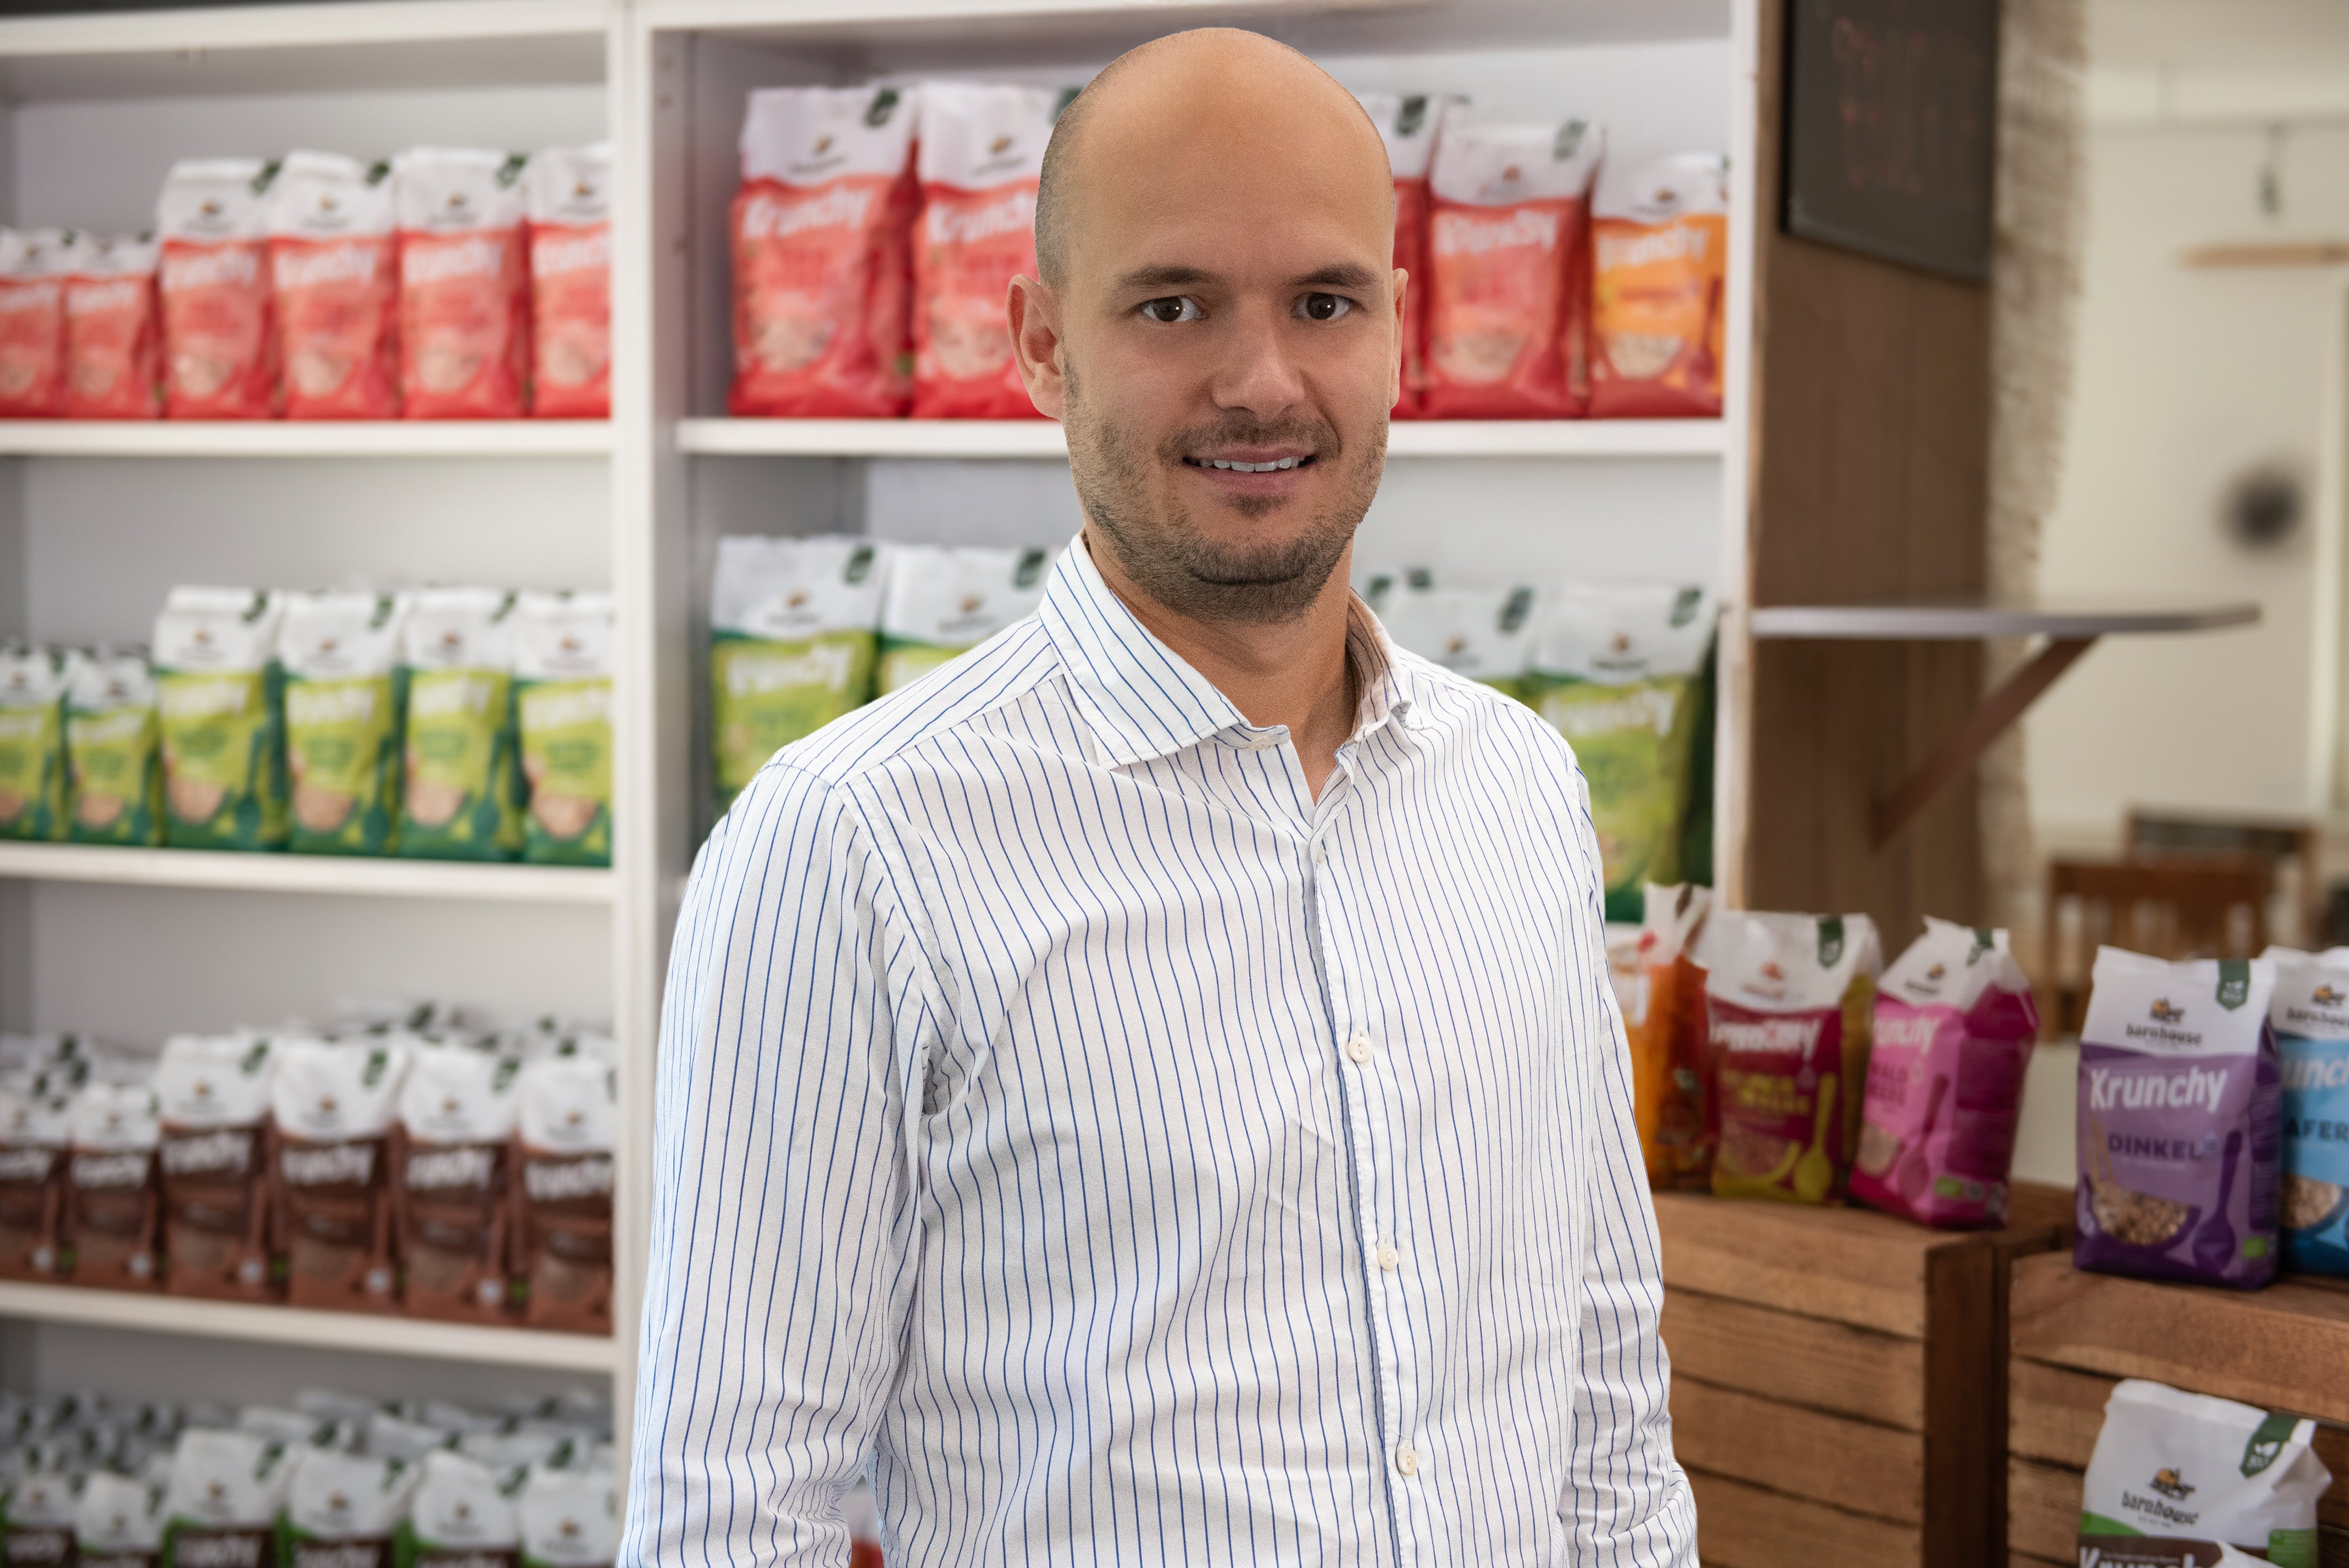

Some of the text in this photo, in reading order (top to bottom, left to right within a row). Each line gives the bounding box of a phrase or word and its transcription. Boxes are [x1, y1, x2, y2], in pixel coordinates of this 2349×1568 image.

[2126, 1021, 2204, 1048] barnhouse
[2090, 1064, 2228, 1114] Krunchy
[2284, 1117, 2349, 1141] AFER
[2108, 1131, 2202, 1162] DINKEL
[2121, 1490, 2200, 1526] barnhouse
